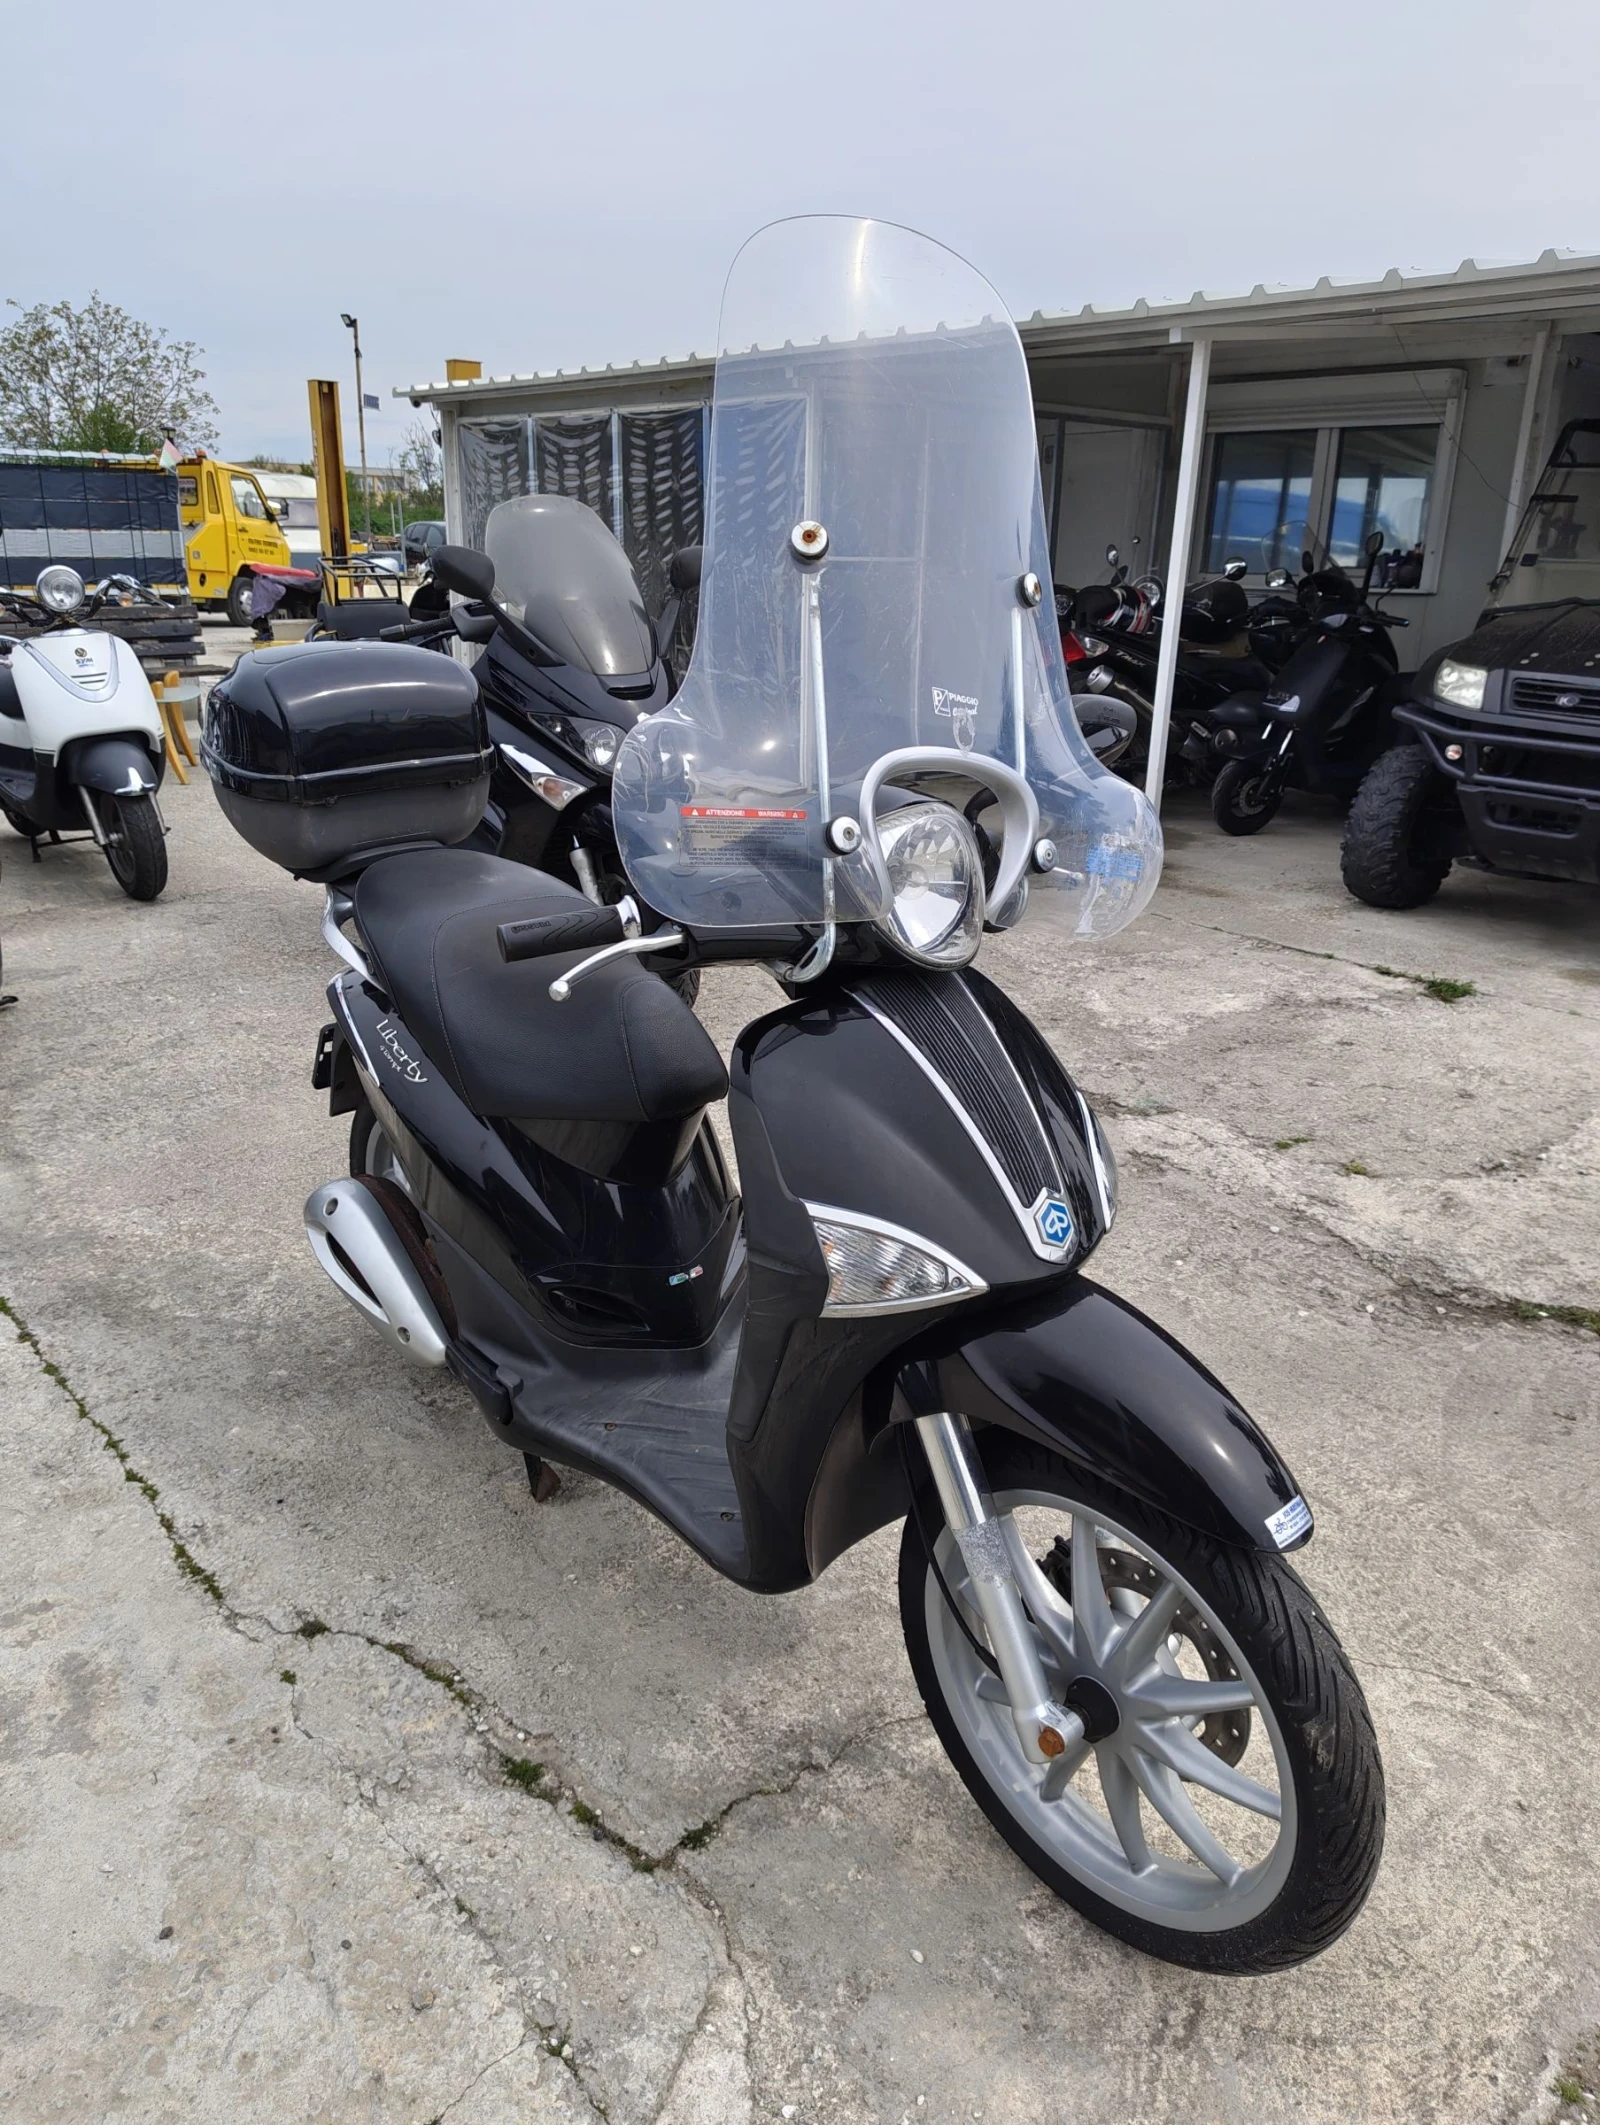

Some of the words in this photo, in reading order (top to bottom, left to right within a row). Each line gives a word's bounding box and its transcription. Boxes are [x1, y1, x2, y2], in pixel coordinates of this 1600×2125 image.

[75, 657, 94, 665] SYM
[949, 692, 979, 706] PIAGGIO
[705, 809, 746, 817] ATTENZIONE!
[376, 1019, 428, 1082] Liberty
